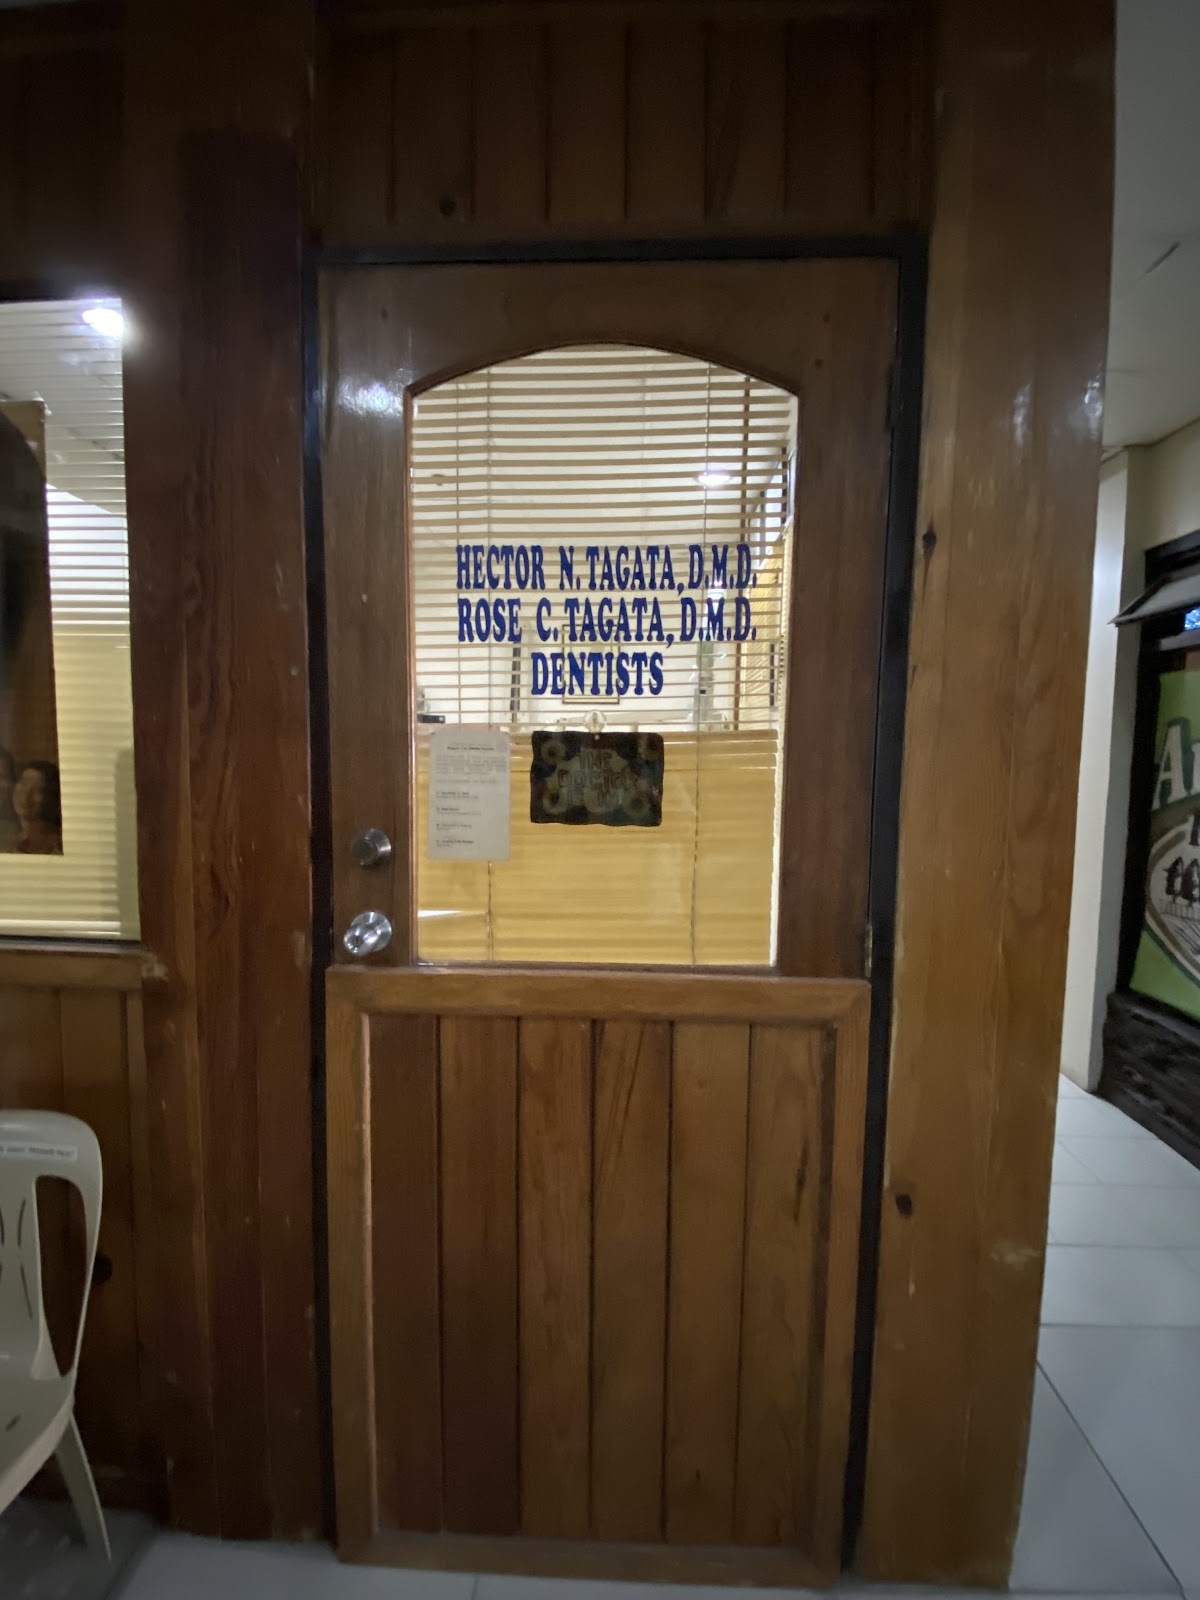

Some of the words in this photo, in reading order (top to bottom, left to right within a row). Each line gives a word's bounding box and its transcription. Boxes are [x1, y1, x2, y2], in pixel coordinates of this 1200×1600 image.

[456, 544, 546, 589] HECTOR
[558, 545, 580, 590] N.
[586, 545, 684, 596] TAGATA,
[687, 543, 758, 589] D.M.D.
[458, 597, 523, 643] ROSE
[536, 597, 559, 642] C.
[564, 597, 675, 648] TAGATA,
[679, 597, 757, 642] D.M.D.
[531, 651, 664, 696] DENTISTS
